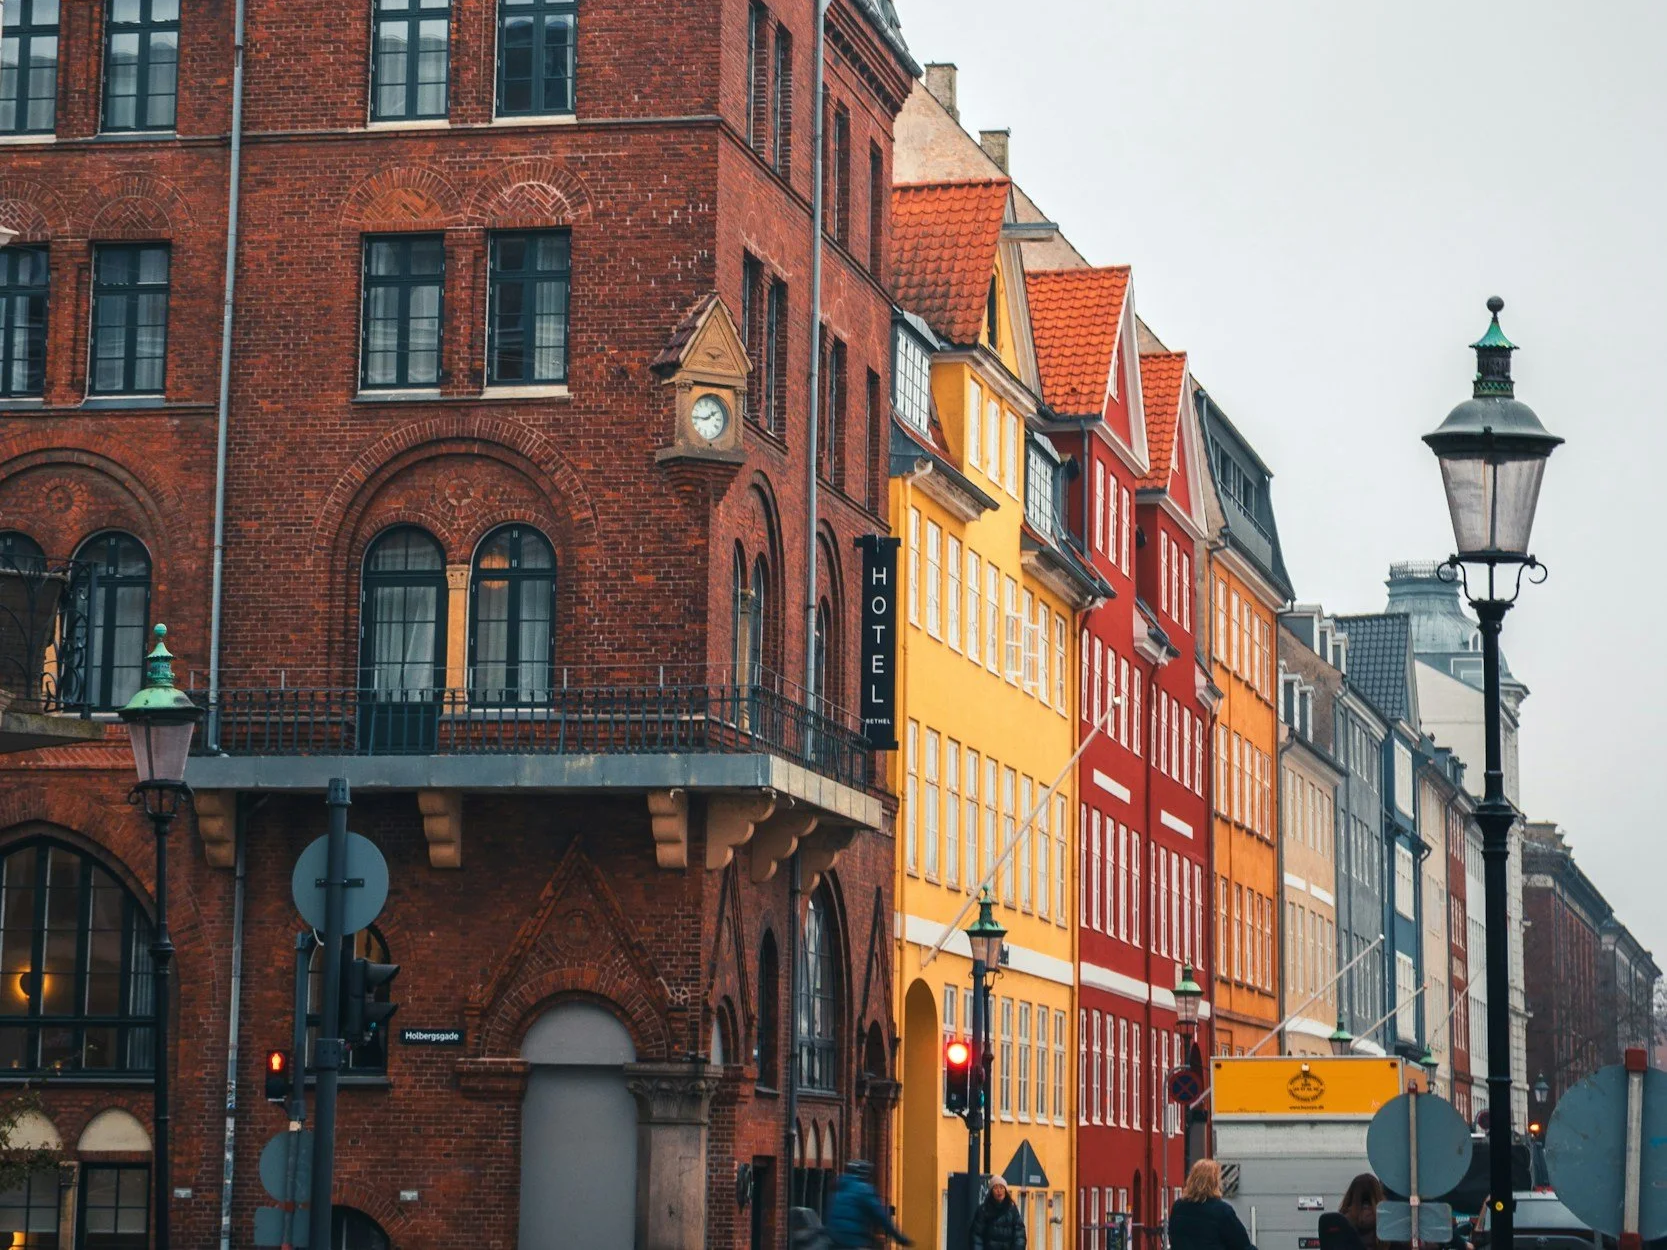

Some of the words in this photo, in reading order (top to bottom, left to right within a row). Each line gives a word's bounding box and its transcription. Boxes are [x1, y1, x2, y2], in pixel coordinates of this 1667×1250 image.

[871, 566, 888, 703] HOTEL
[865, 717, 891, 725] BETHEL
[405, 1031, 459, 1042] Holbergsgade
